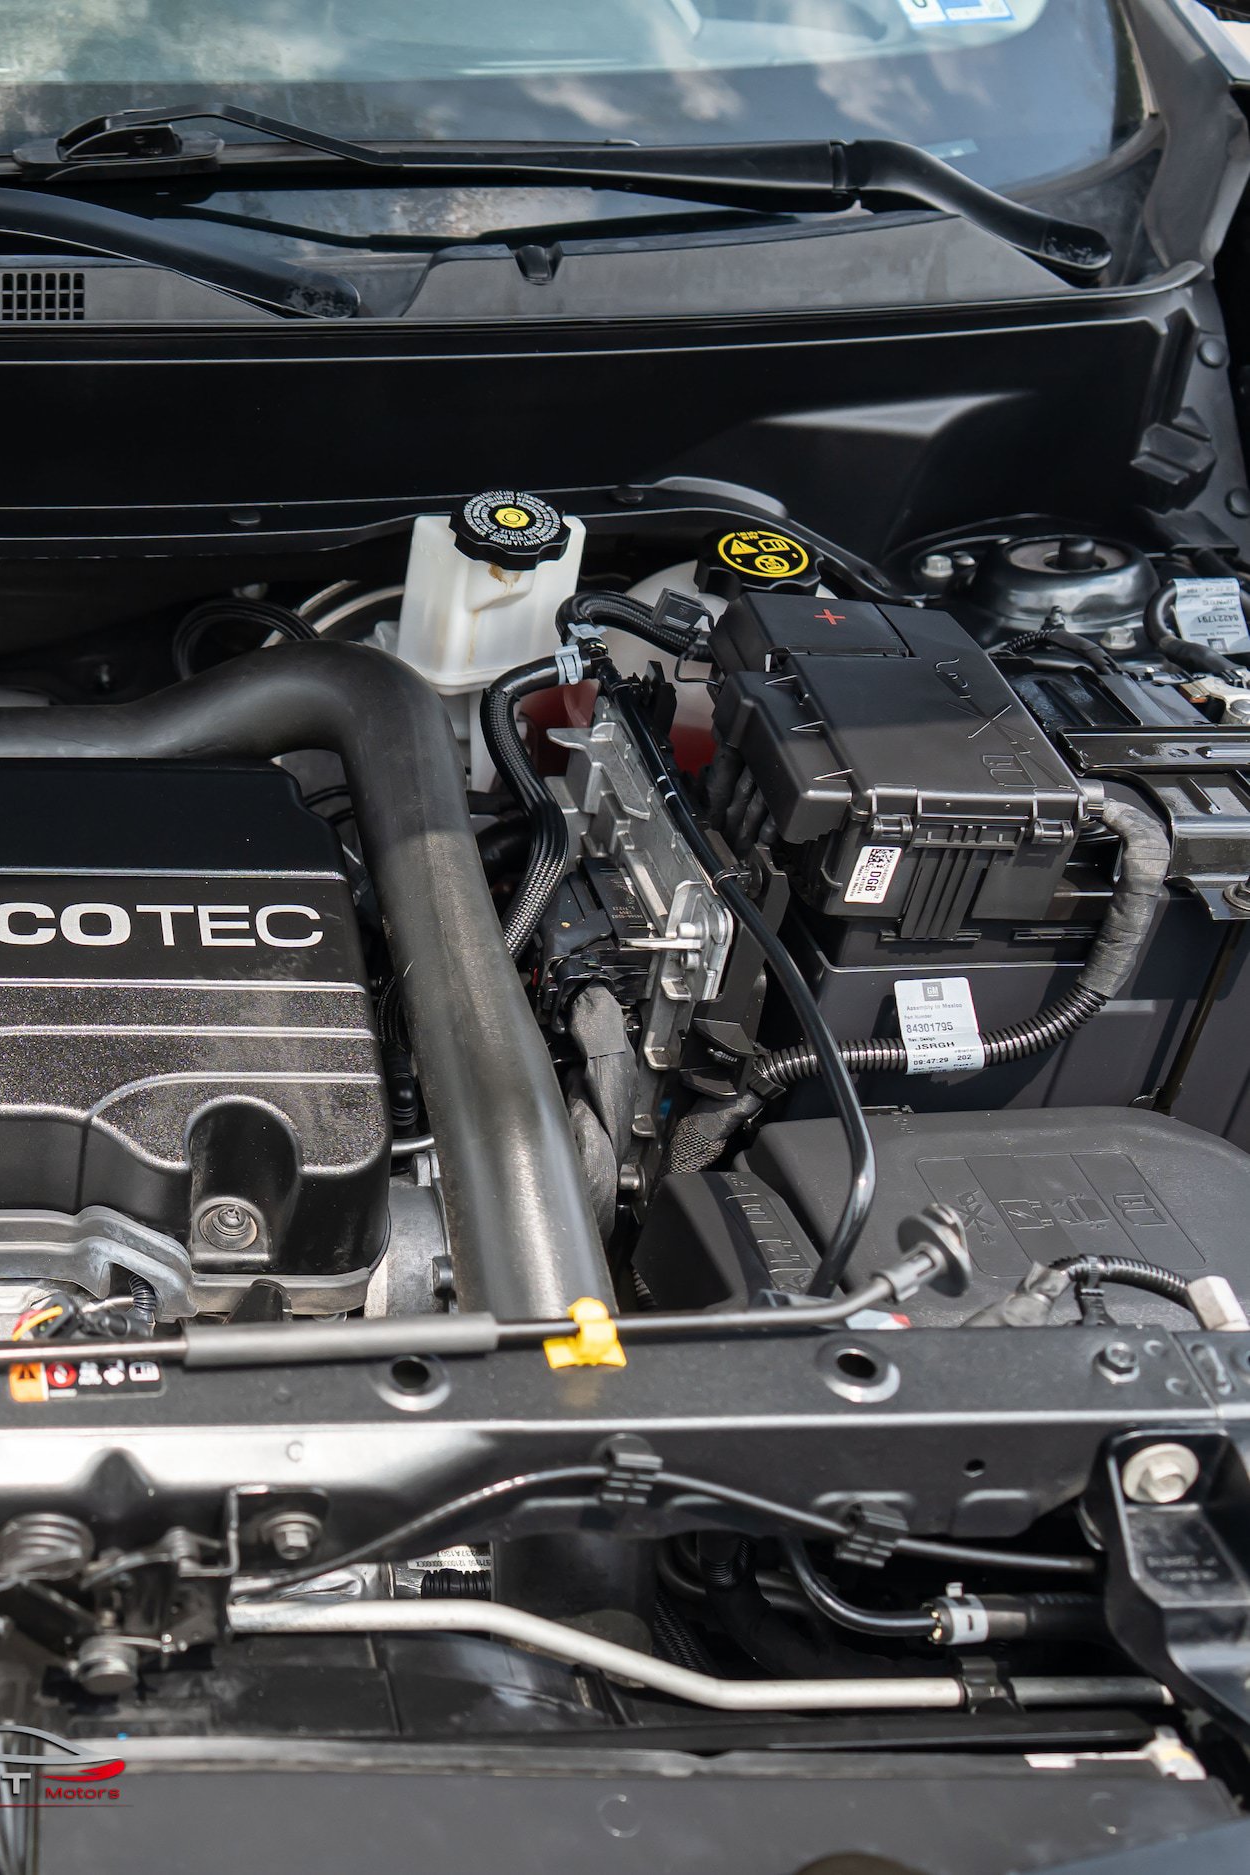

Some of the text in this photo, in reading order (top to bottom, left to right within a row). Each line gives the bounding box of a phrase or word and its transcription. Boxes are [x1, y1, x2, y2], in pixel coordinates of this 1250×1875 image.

[865, 871, 881, 892] DGB
[926, 986, 939, 996] GM
[906, 1021, 954, 1033] 84301795
[913, 1057, 949, 1065] 09:47:29
